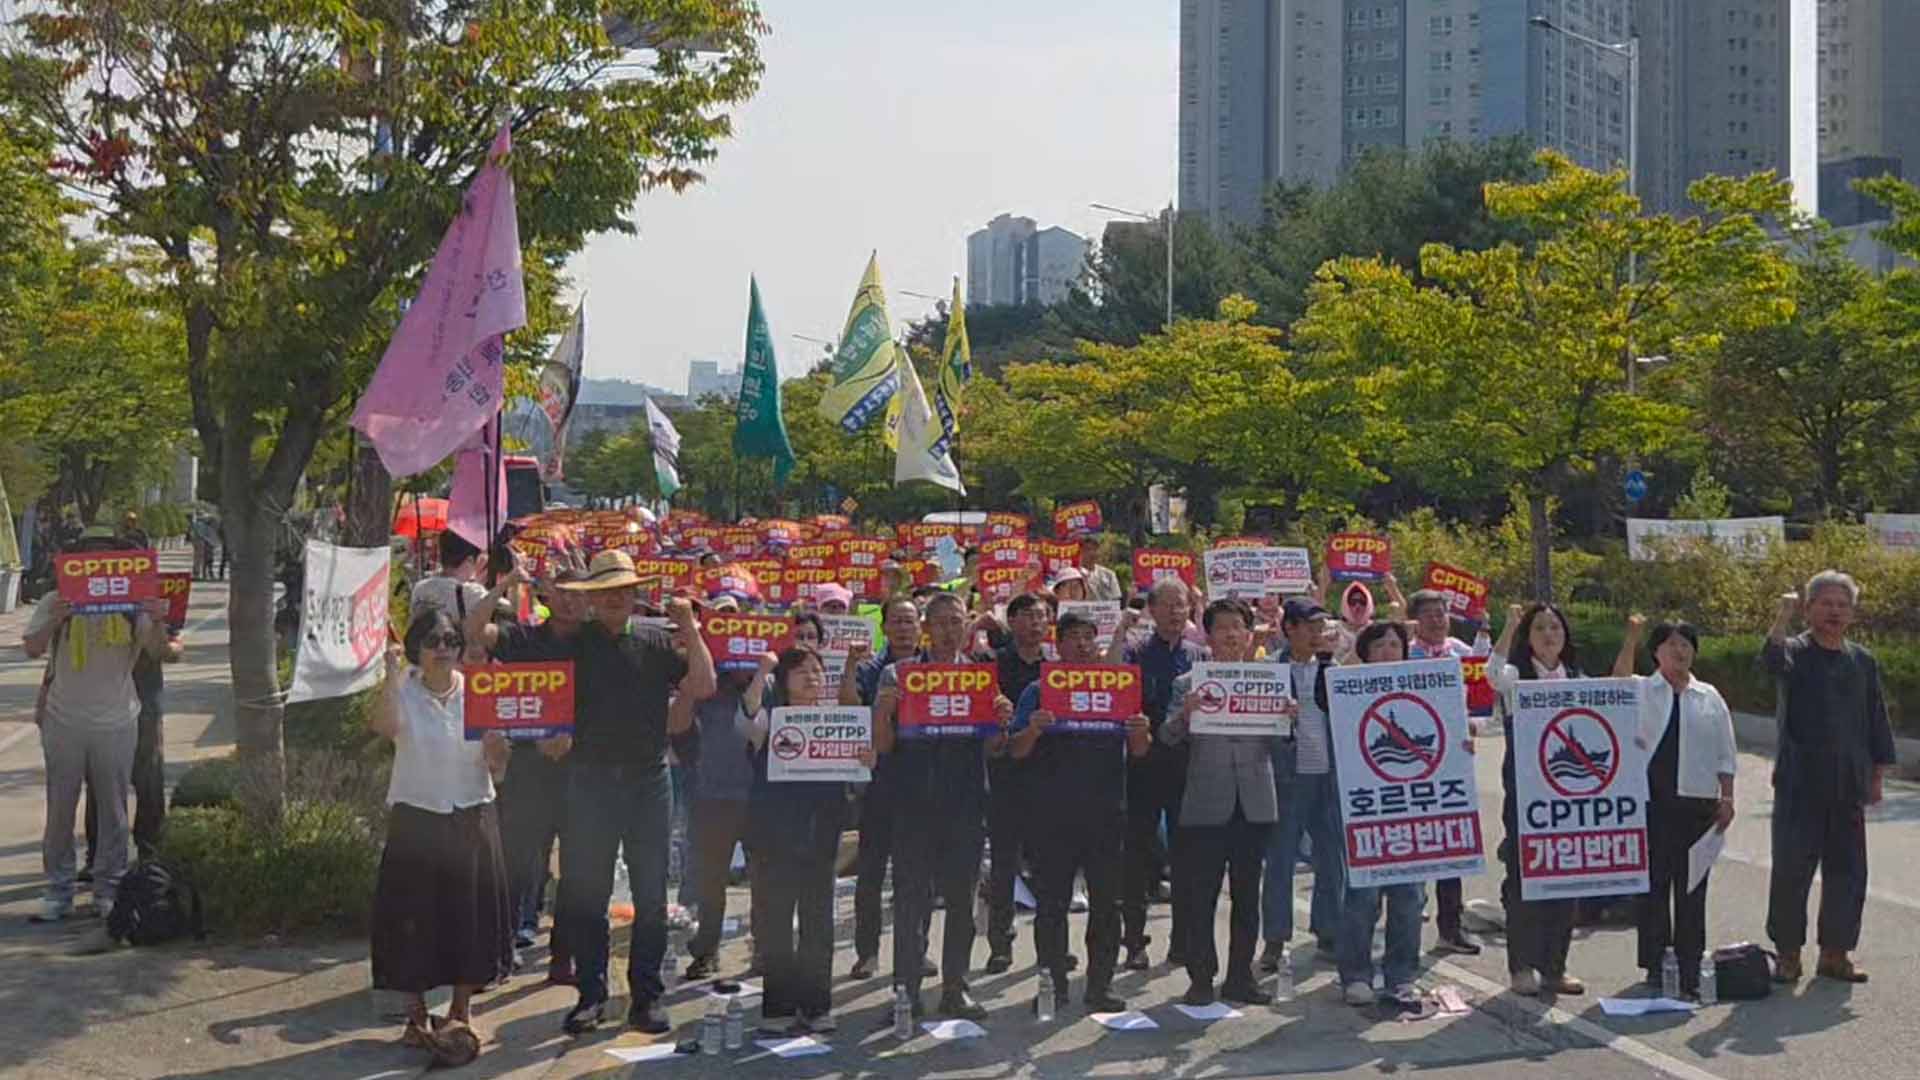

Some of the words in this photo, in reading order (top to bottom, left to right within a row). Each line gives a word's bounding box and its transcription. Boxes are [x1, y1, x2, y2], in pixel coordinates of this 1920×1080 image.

[1331, 538, 1387, 553] CPTPP
[63, 557, 152, 576] CPTPP
[636, 560, 688, 575] CPTPP
[1138, 554, 1192, 569] CPTPP
[784, 568, 836, 583] CPTPP
[1431, 568, 1486, 596] CPTPP
[707, 617, 789, 637] CPTPP
[471, 671, 567, 695] CPTPP
[906, 671, 992, 694] CPTPP
[1047, 670, 1134, 691] CPTPP
[1232, 681, 1285, 694] CPTPP
[812, 726, 867, 739] CPTPP
[1348, 779, 1469, 818] 호르무즈
[1526, 797, 1638, 830] CPTPP
[1352, 817, 1476, 859] 파병반대
[1527, 832, 1641, 871] 가입반대
